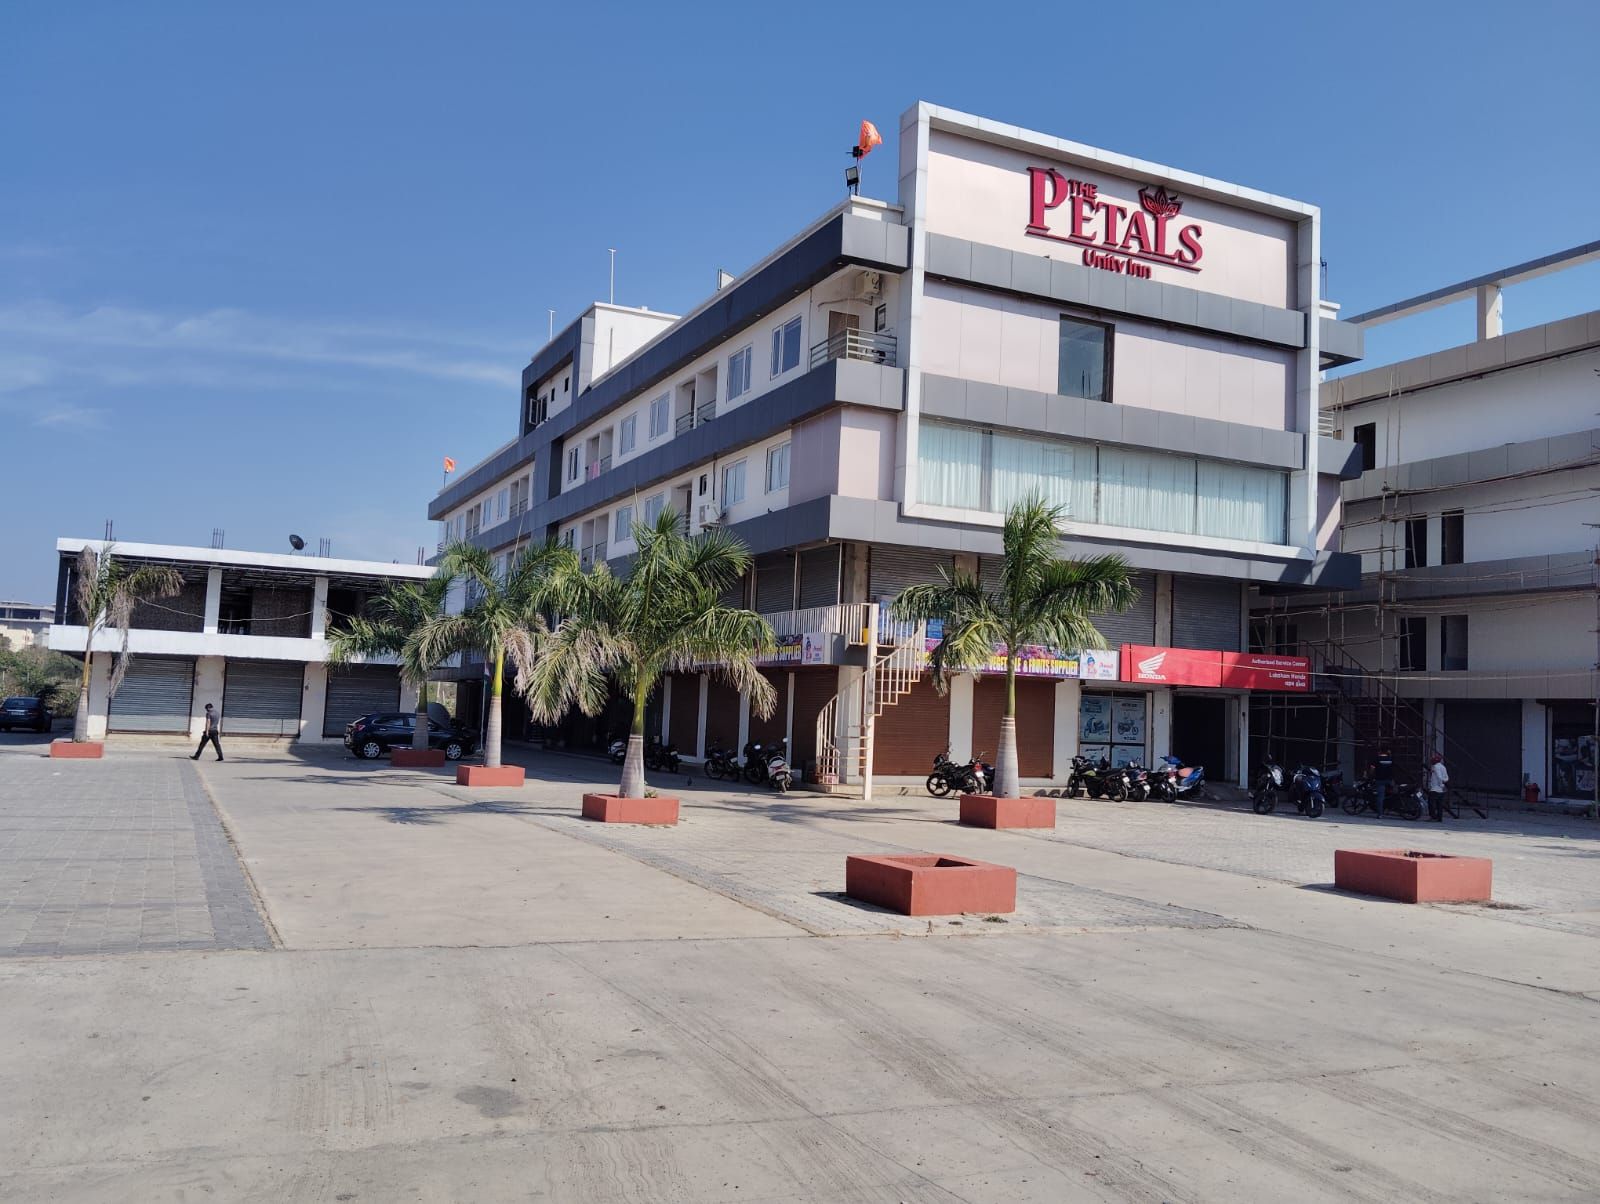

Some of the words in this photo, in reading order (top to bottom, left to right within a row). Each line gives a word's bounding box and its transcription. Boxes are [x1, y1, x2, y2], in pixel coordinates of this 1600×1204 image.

[1068, 179, 1098, 199] THE
[1026, 166, 1203, 264] PETALS
[1082, 248, 1125, 273] Unity
[1126, 258, 1152, 280] Inn
